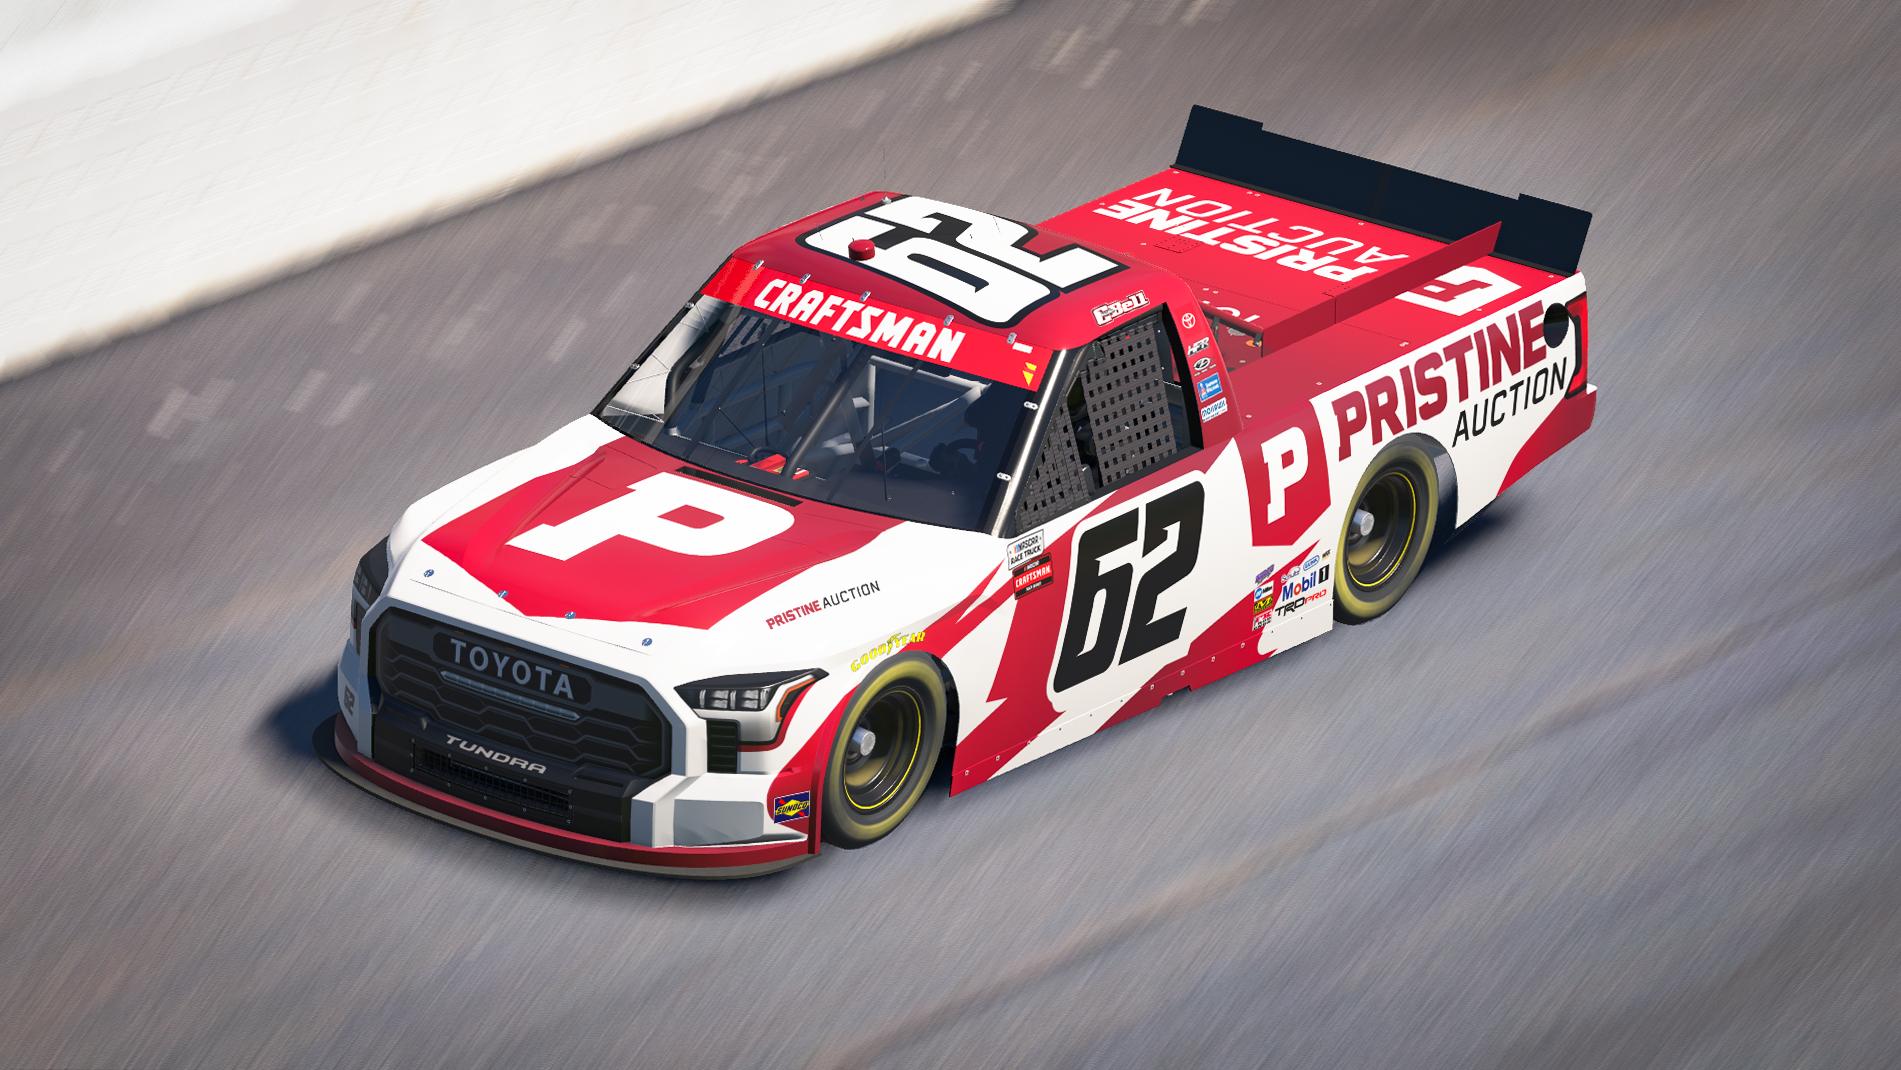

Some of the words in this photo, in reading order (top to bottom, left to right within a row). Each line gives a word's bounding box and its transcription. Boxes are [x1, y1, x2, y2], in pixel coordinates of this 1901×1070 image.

[799, 195, 1127, 326] 62
[1092, 200, 1379, 283] PRISTINE
[1132, 187, 1409, 265] AUCTION
[753, 278, 966, 364] CRAFTSMAN
[1331, 300, 1547, 462] PRISTINE
[1452, 357, 1567, 448] AUCTION
[1260, 426, 1309, 525] P
[504, 471, 795, 561] P
[1010, 553, 1023, 565] RACE
[1024, 545, 1041, 559] TRUCK
[766, 600, 822, 629] PRISTINE
[823, 580, 880, 609] AUCTION
[1015, 565, 1051, 588] CRAFTSMAN
[1053, 481, 1205, 693] 62
[1282, 571, 1316, 601] Mobil
[451, 638, 574, 700] TOYOTA
[850, 631, 926, 672] GOODYEAR
[446, 734, 547, 774] TUNDRA
[776, 801, 809, 815] SUNOCO
